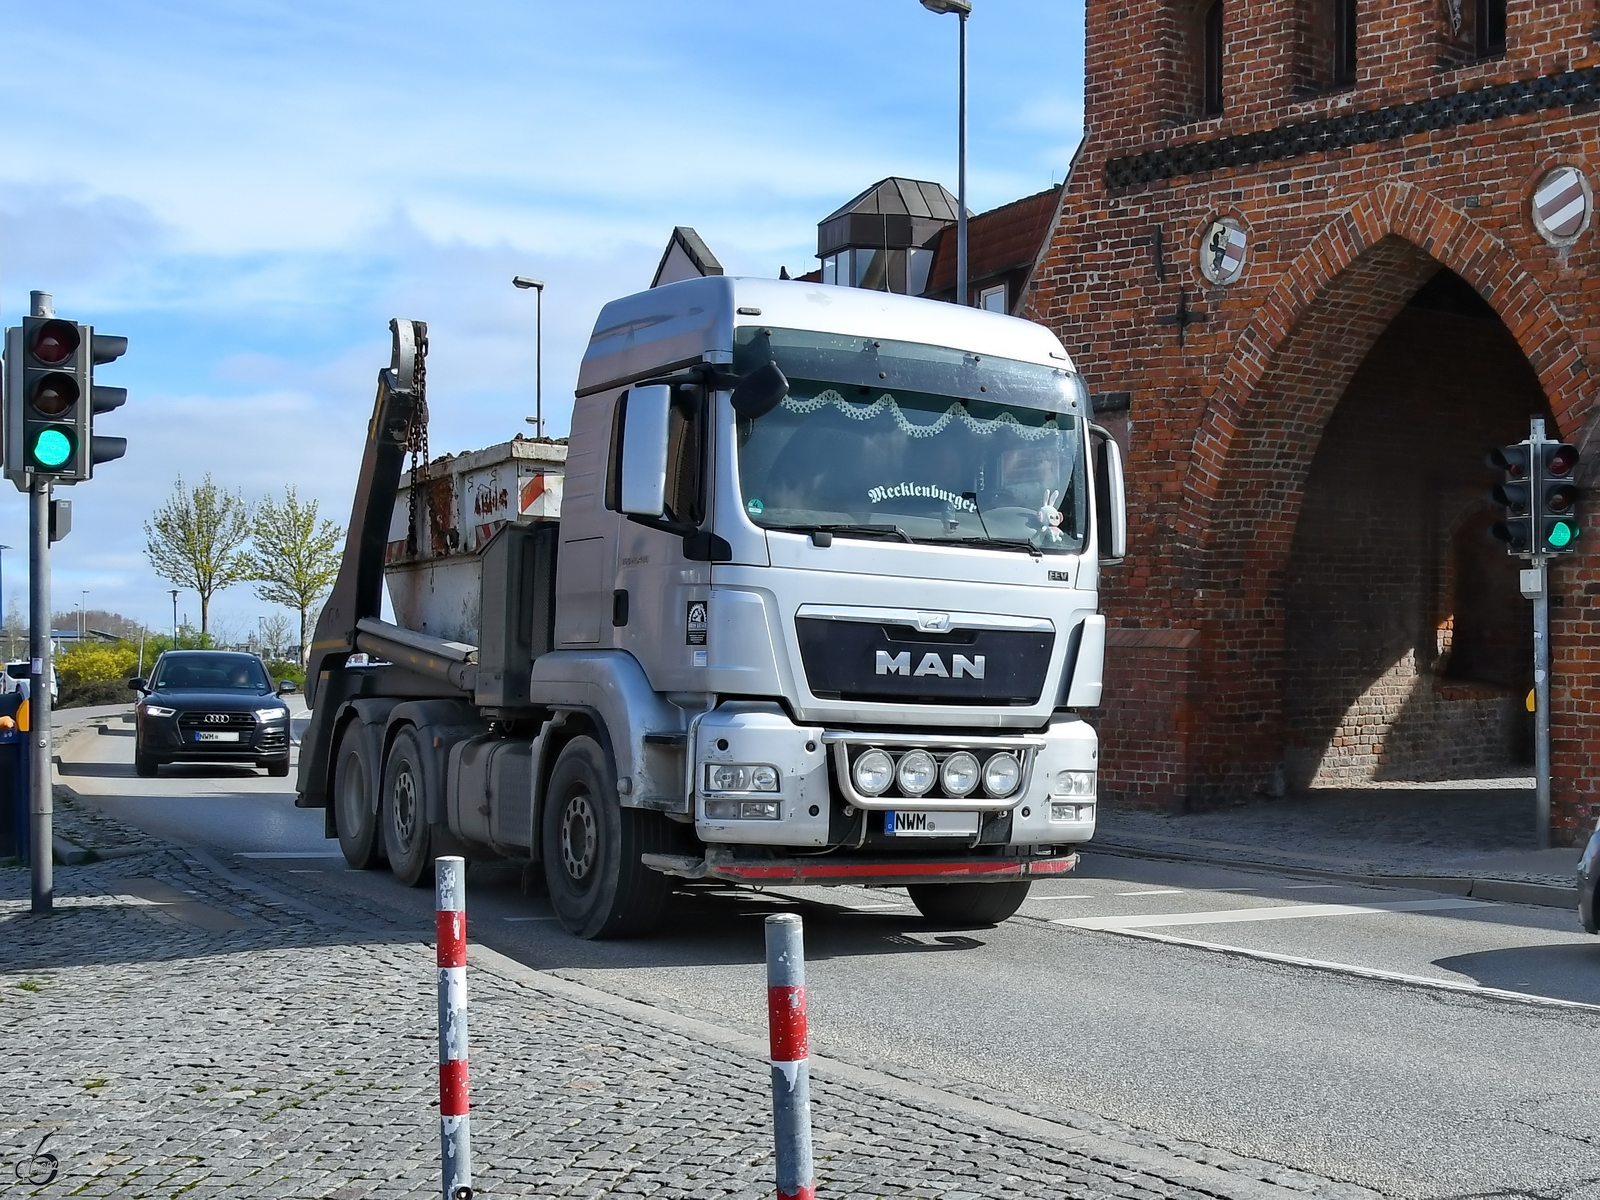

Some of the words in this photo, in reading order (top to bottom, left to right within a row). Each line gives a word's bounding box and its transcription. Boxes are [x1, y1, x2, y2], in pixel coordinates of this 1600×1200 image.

[867, 481, 978, 513] Mecklenburger
[875, 650, 986, 680] MAN
[895, 812, 927, 831] NWM
